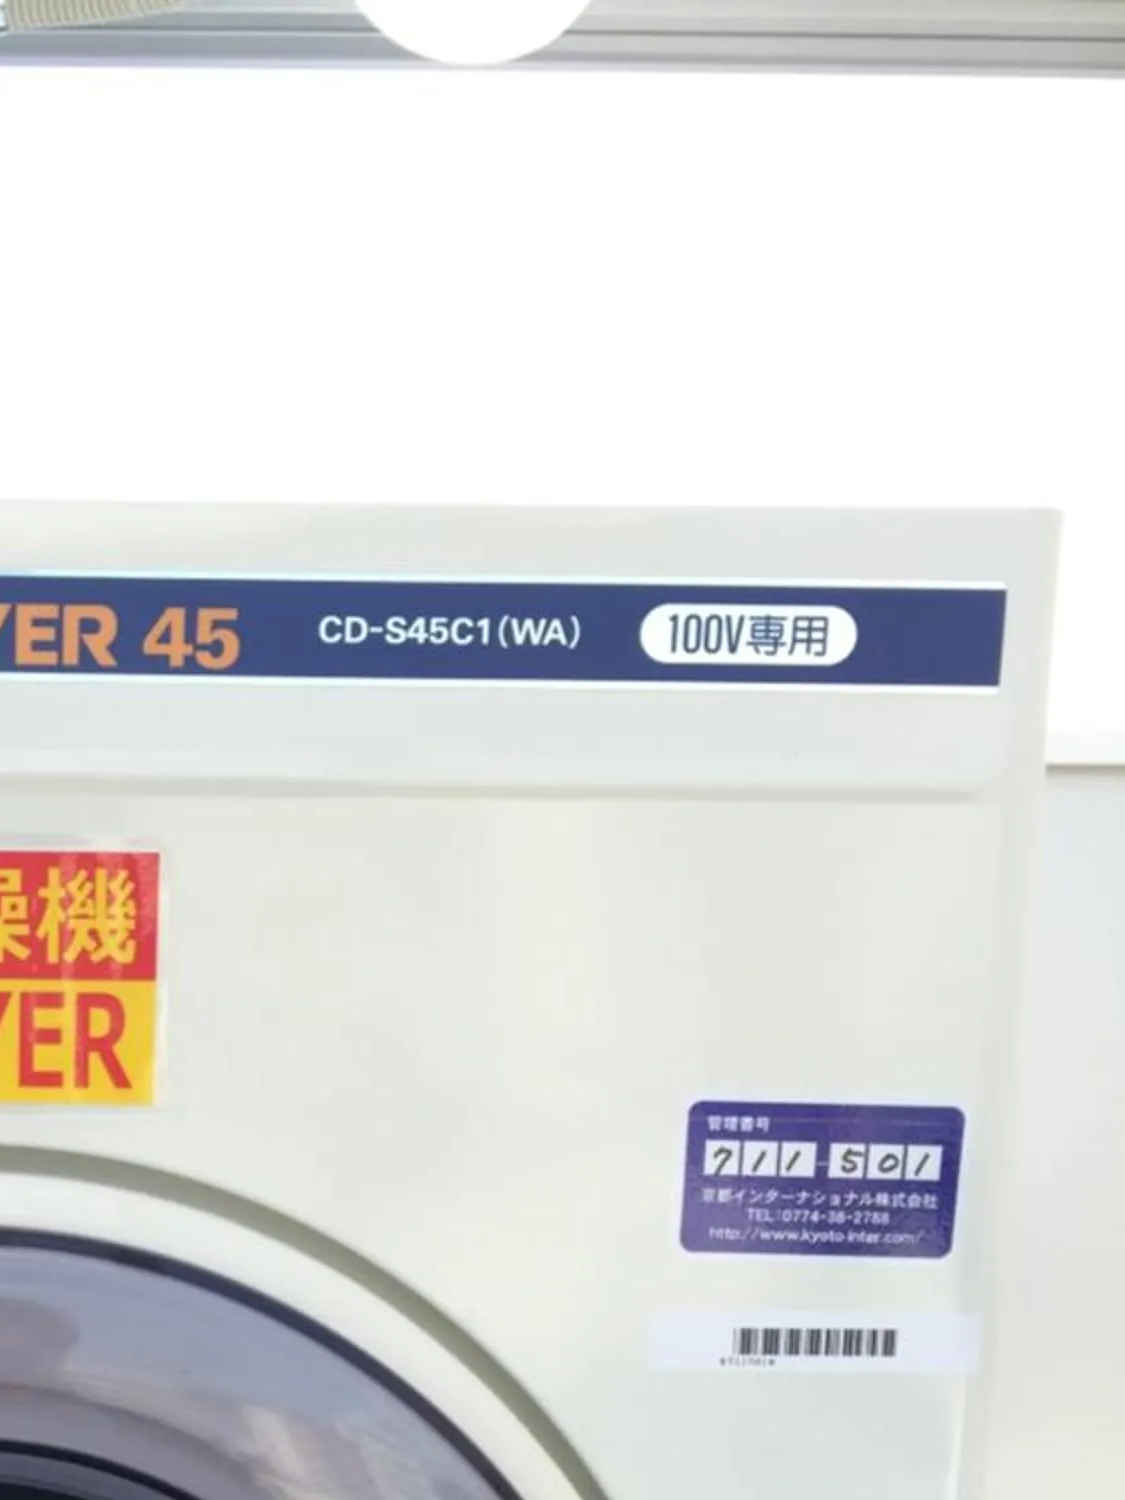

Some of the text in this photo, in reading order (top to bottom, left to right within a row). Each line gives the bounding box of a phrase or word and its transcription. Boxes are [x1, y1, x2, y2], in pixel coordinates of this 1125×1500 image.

[142, 607, 241, 669] 45
[667, 612, 830, 658] 100V専用
[707, 1115, 771, 1133] 管理番号
